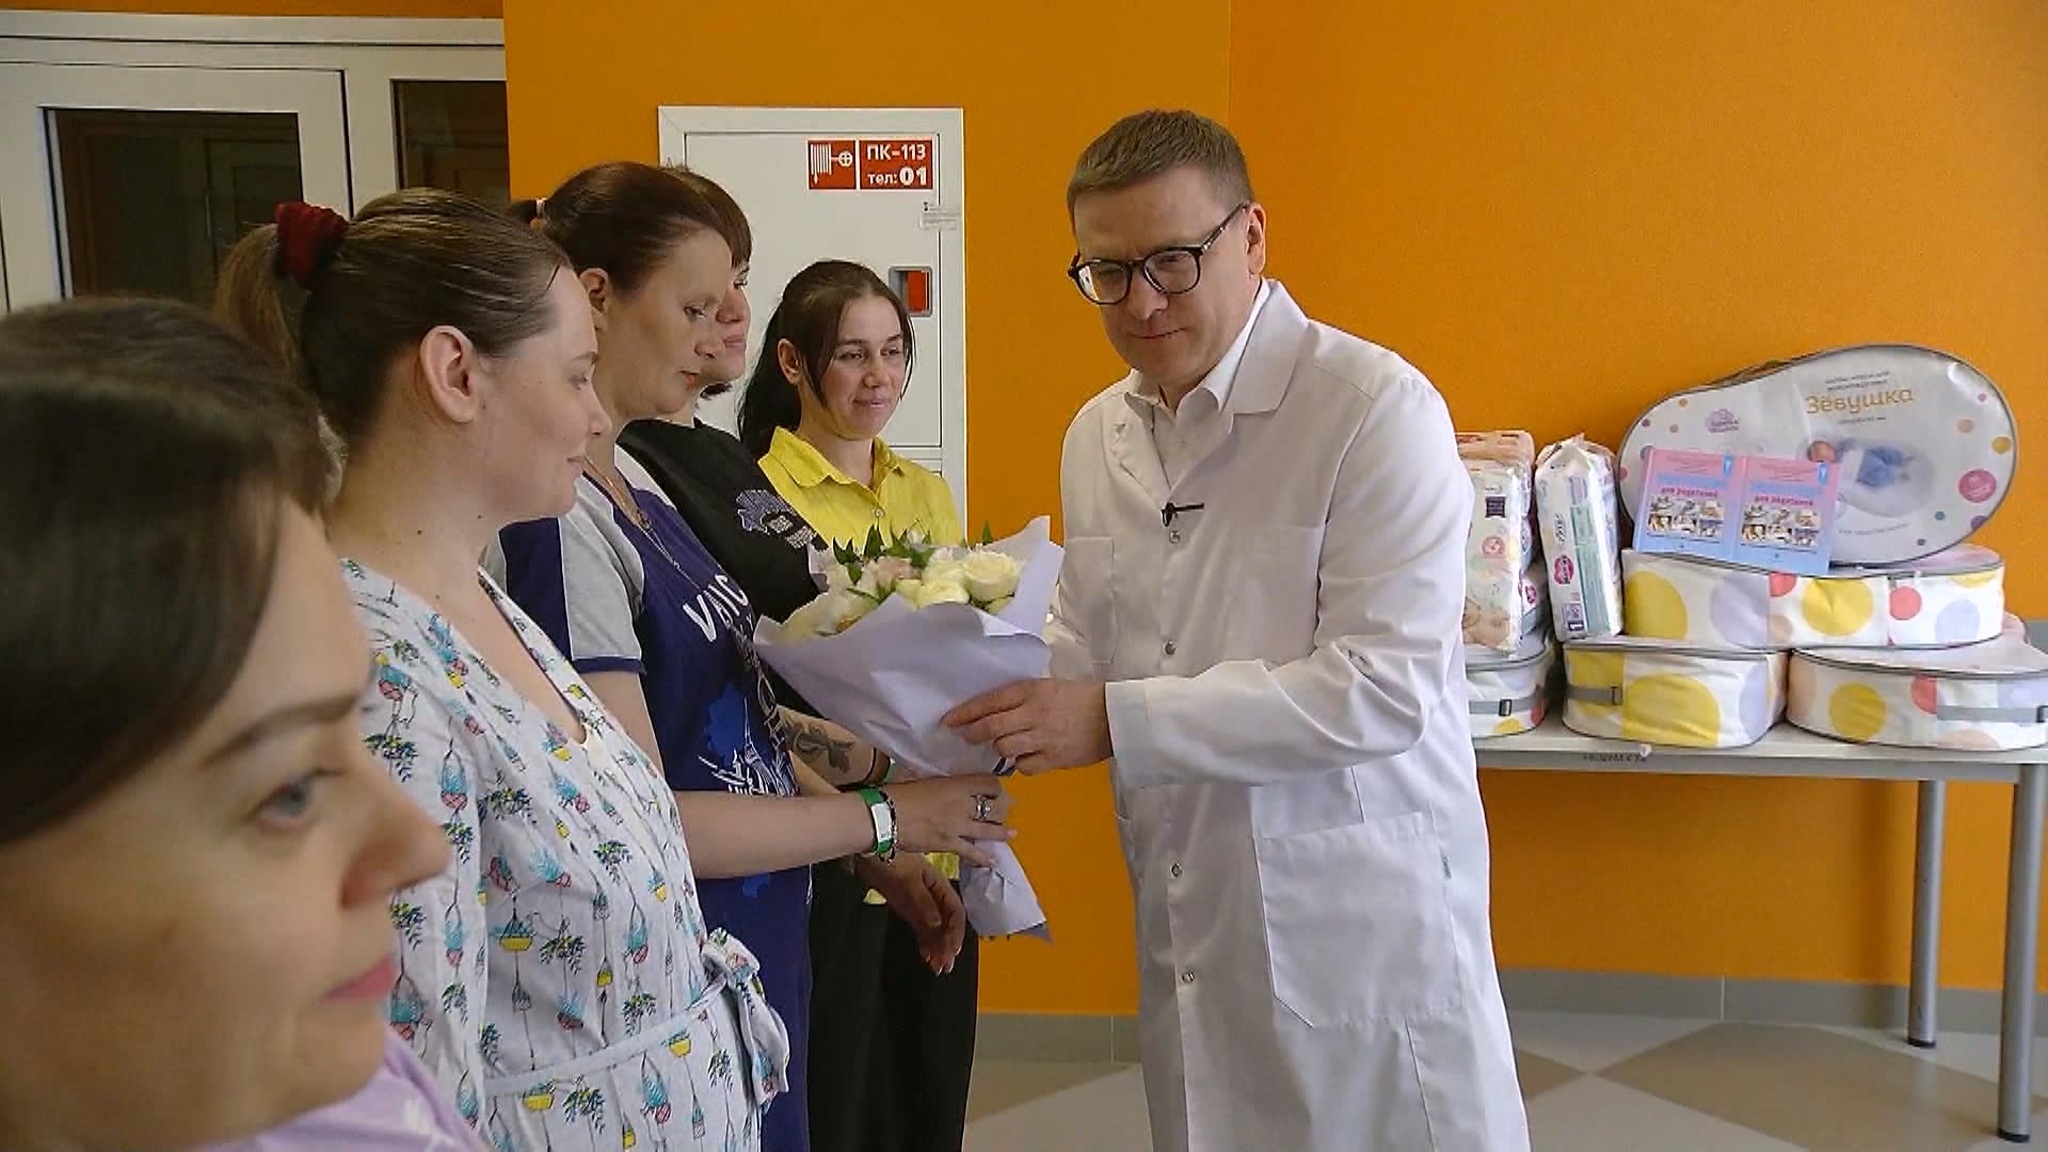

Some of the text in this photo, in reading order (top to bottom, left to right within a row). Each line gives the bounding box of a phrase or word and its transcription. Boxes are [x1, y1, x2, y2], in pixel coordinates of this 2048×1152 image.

[867, 143, 926, 160] ПК-113
[899, 166, 927, 186] 01
[1805, 389, 1914, 414] Зёвушка
